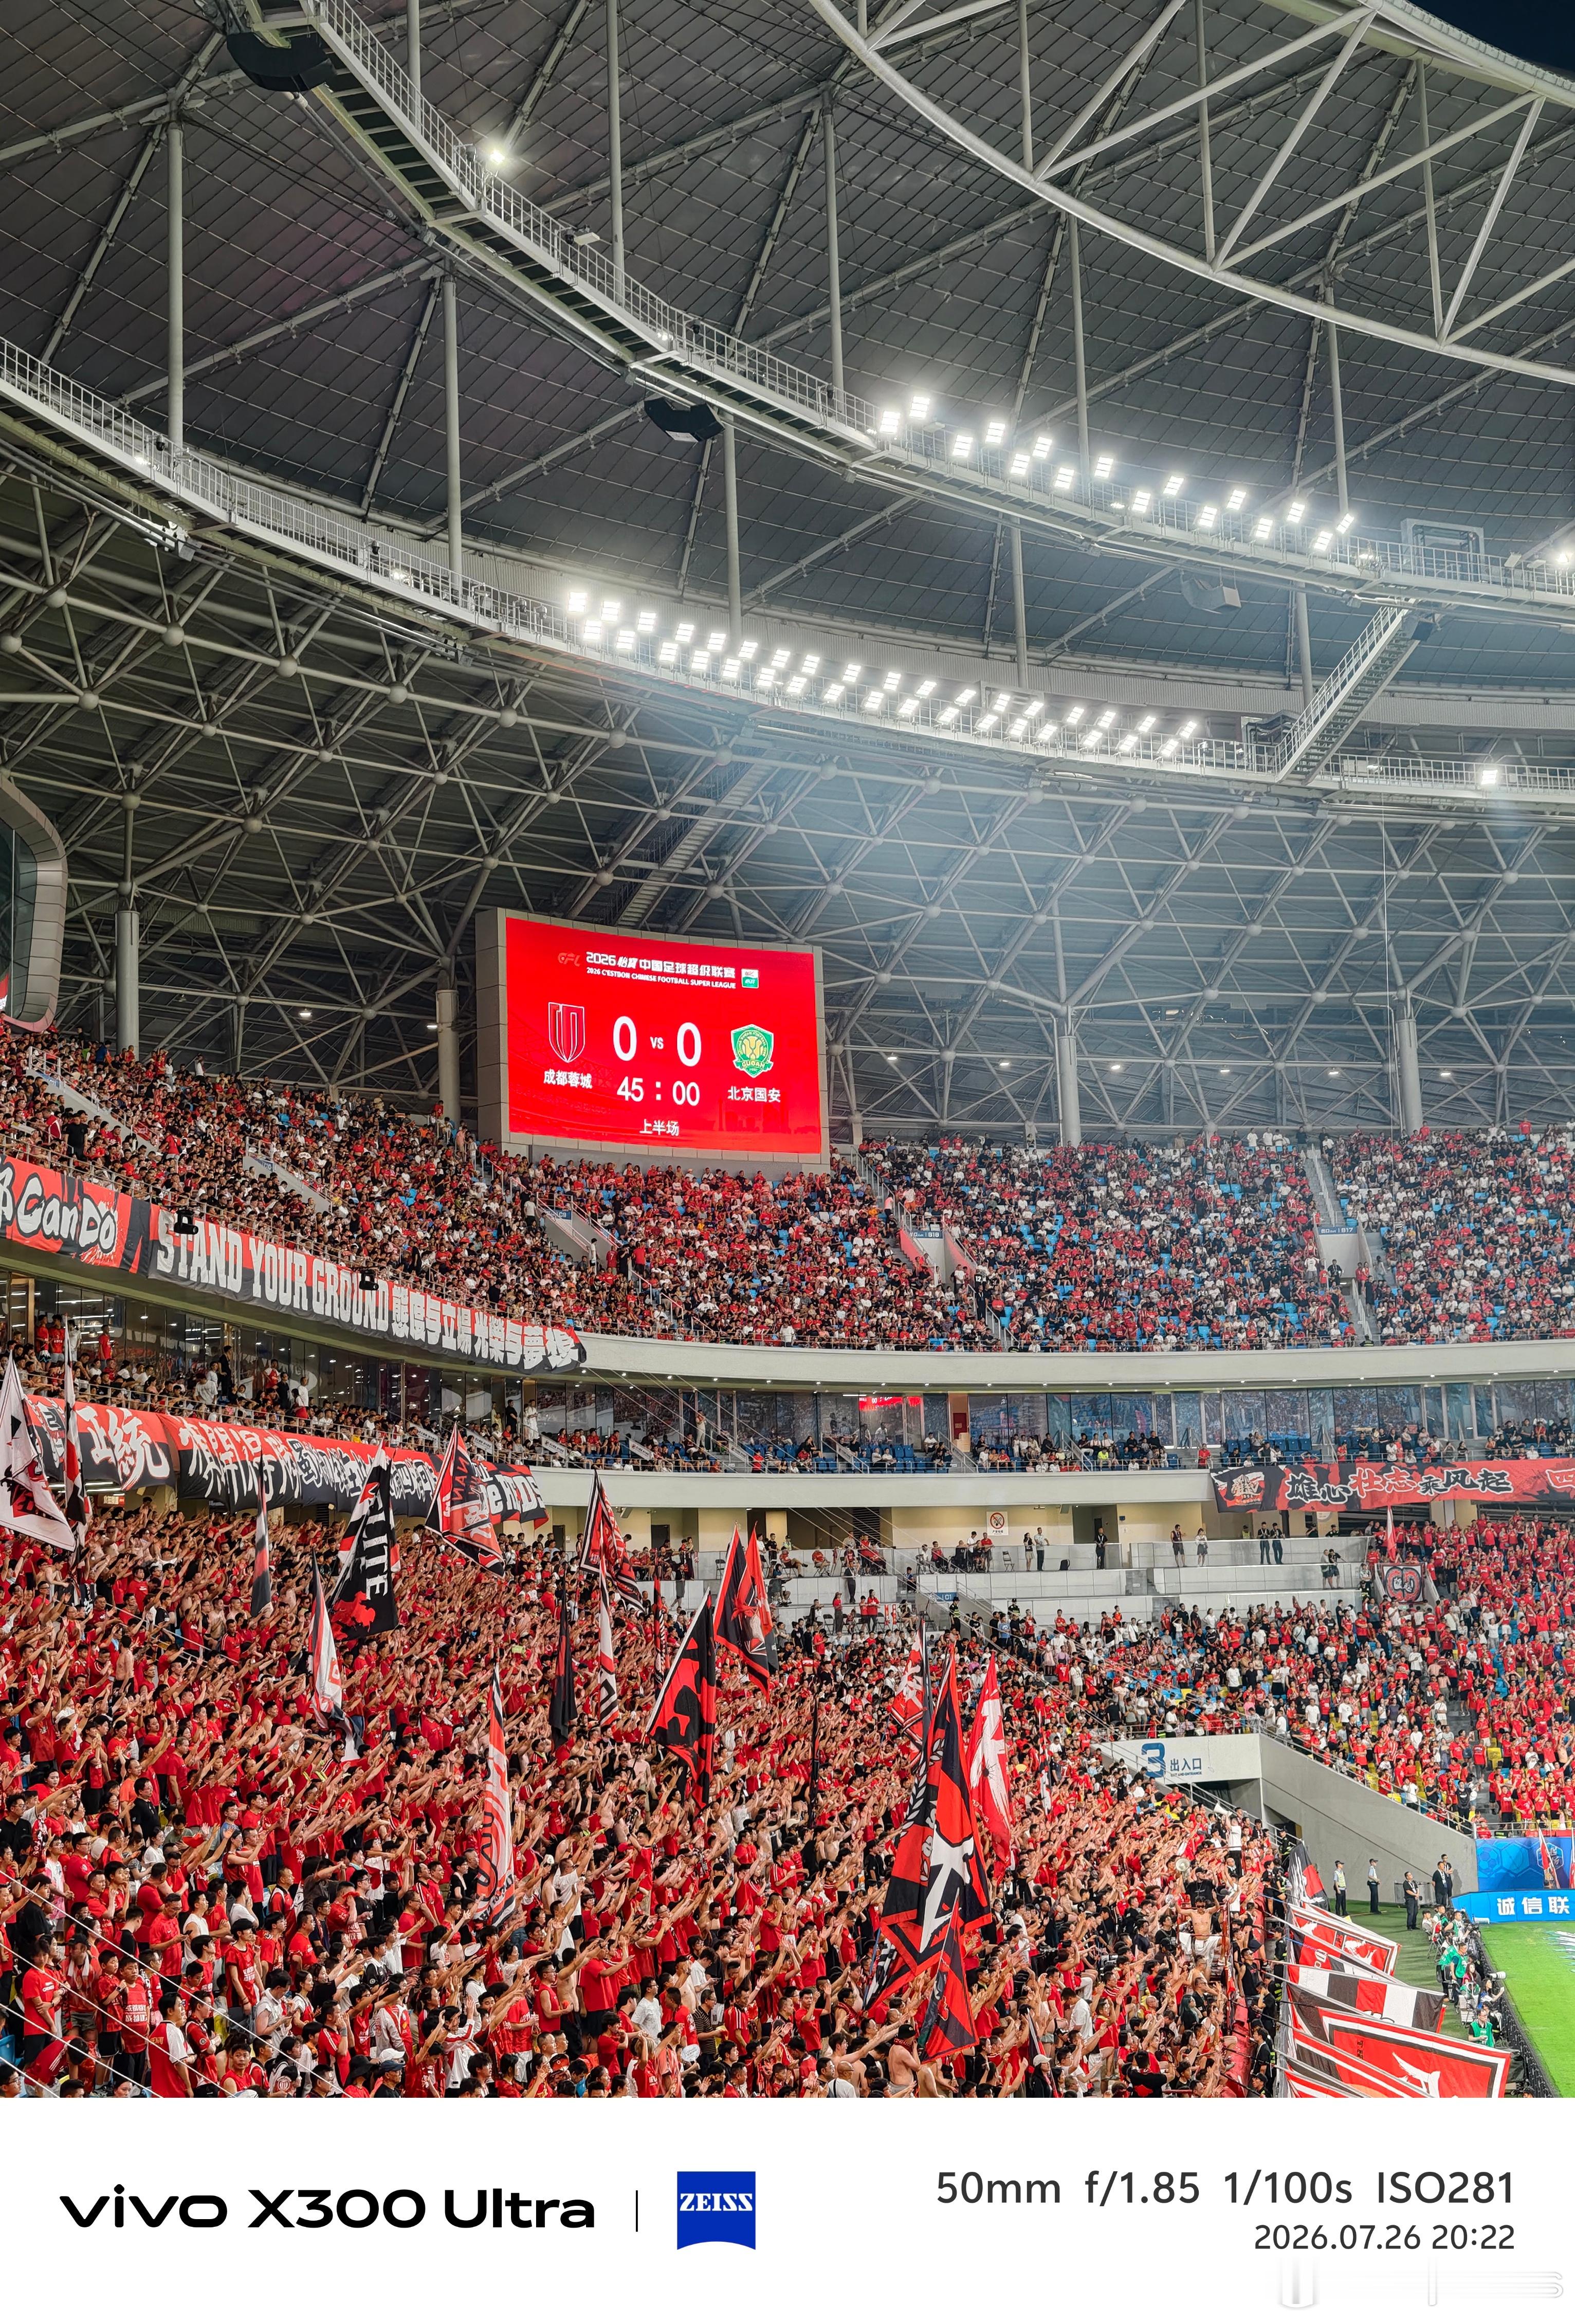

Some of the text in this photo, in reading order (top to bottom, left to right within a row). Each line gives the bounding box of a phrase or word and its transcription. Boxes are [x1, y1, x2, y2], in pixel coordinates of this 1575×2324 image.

[657, 975, 689, 985] FOOTBALL
[690, 978, 710, 987] SUPER
[711, 981, 736, 989] LEAGUE
[613, 1016, 637, 1061] 0
[677, 1022, 702, 1067] 0
[543, 1068, 592, 1089] 成都蓉城
[727, 1086, 781, 1102] 北京国安
[639, 1118, 679, 1136] 上半场
[157, 1209, 389, 1332] STAND YOUR GROUND
[1285, 1466, 1514, 1505] 雄心壮志乘风起
[1141, 1742, 1166, 1778] 3
[1170, 1758, 1202, 1772] 出入口
